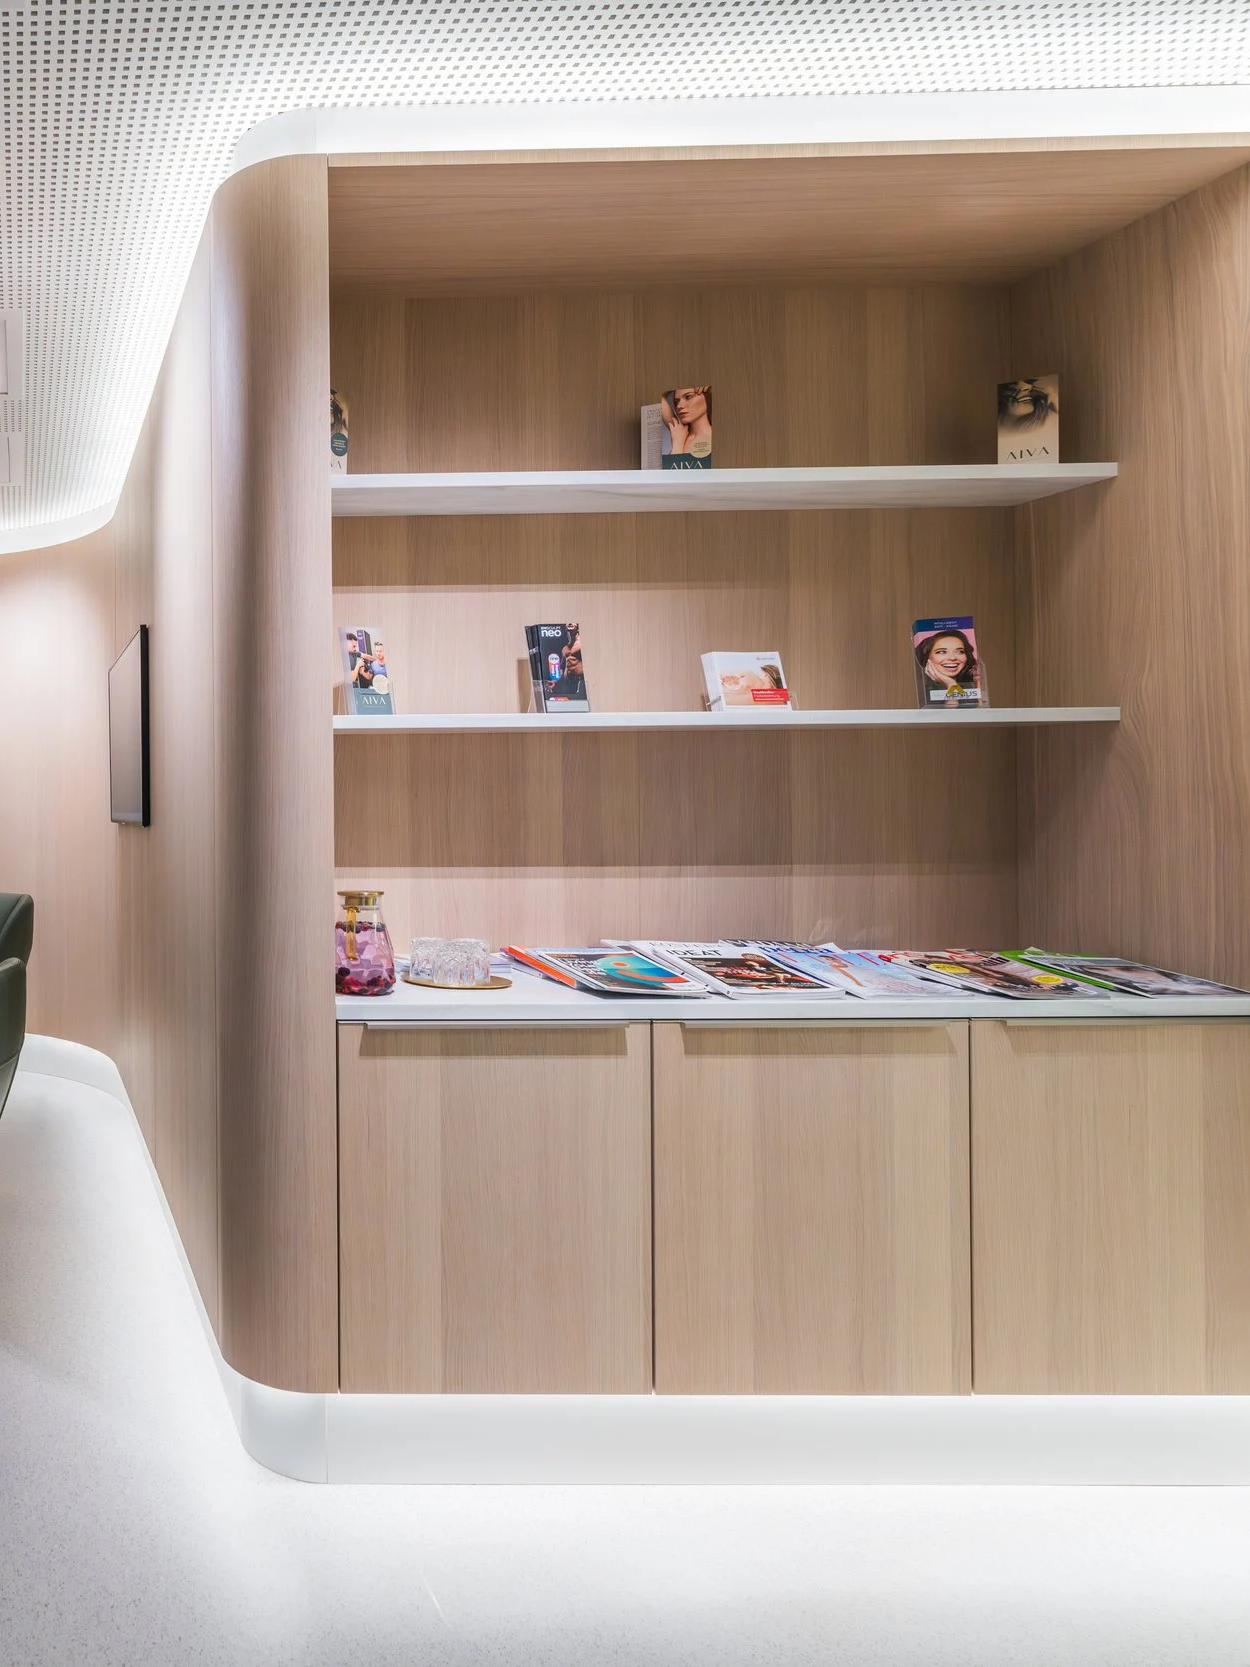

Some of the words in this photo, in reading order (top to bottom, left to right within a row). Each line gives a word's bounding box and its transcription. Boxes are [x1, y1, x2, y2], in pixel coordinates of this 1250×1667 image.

[1006, 446, 1049, 460] AIVA
[670, 460, 703, 469] AIVA
[541, 629, 562, 637] neo
[362, 696, 386, 705] AIVA
